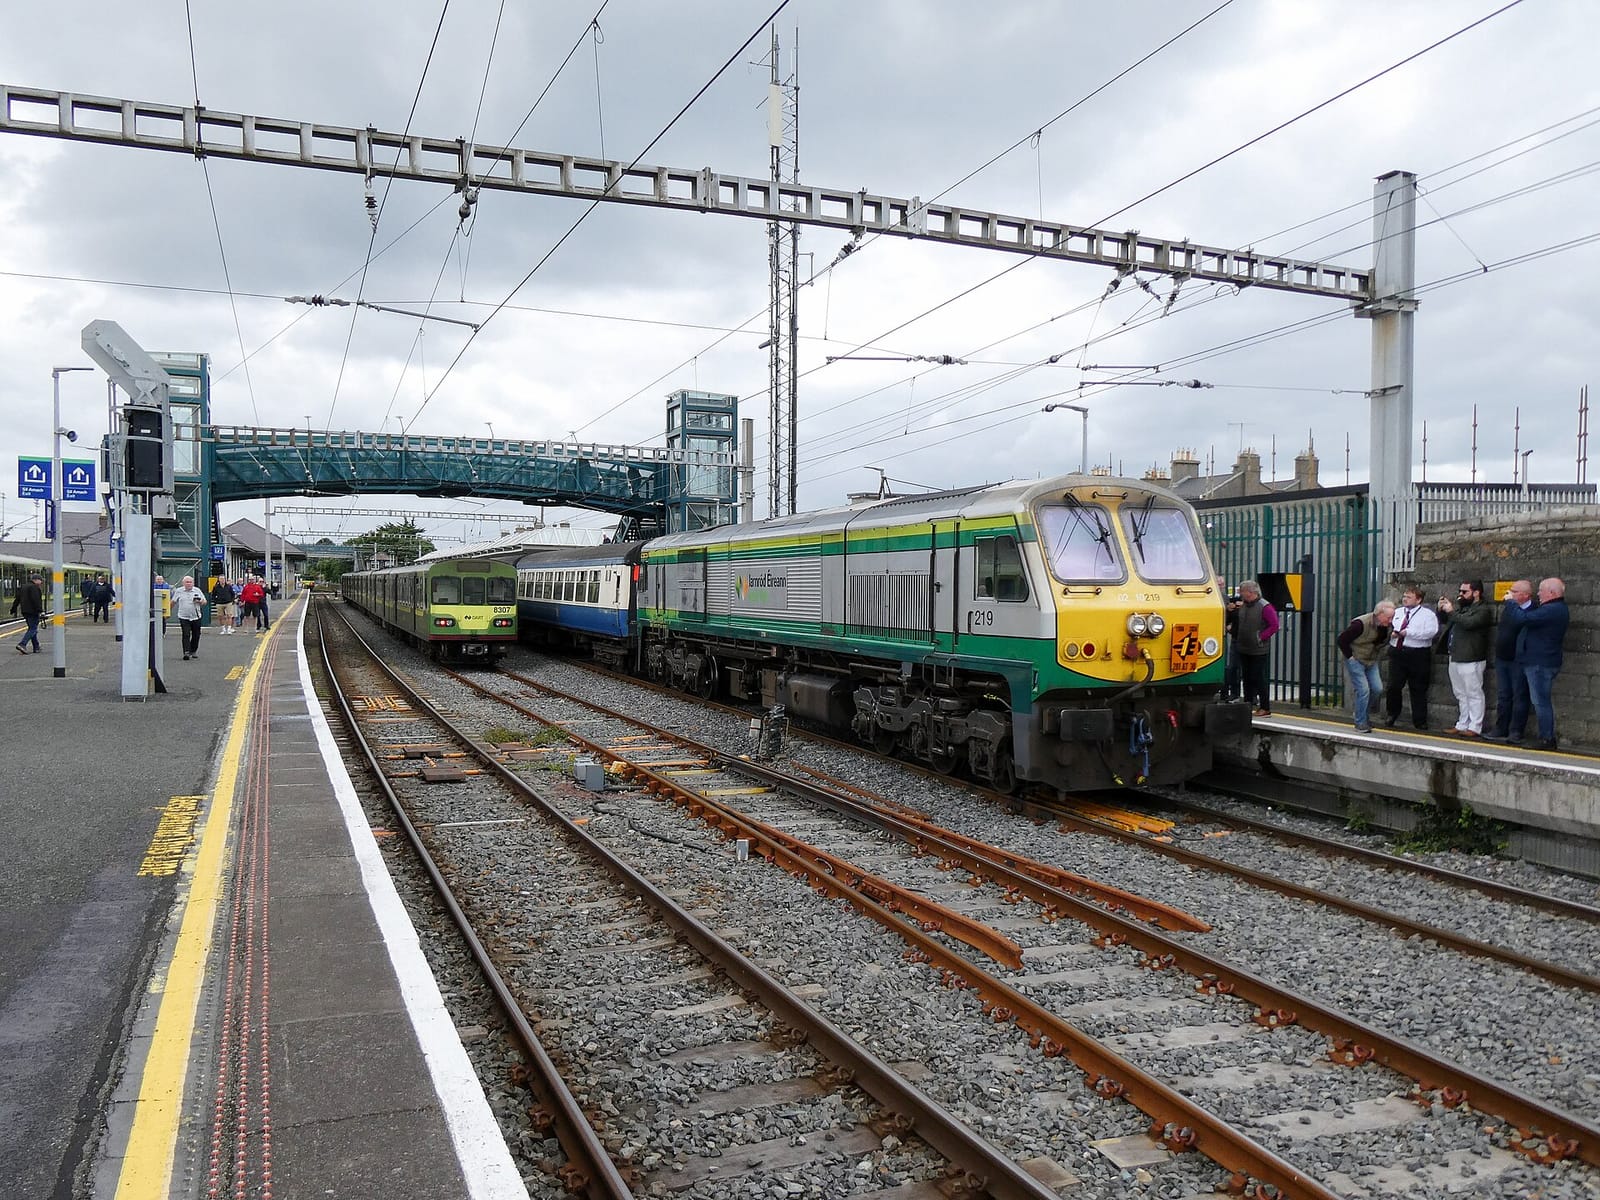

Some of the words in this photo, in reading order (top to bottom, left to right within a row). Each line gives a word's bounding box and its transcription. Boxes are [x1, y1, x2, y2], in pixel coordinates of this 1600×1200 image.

[749, 574, 767, 588] Iarnród
[767, 569, 787, 588] Éireann
[974, 610, 993, 626] 219
